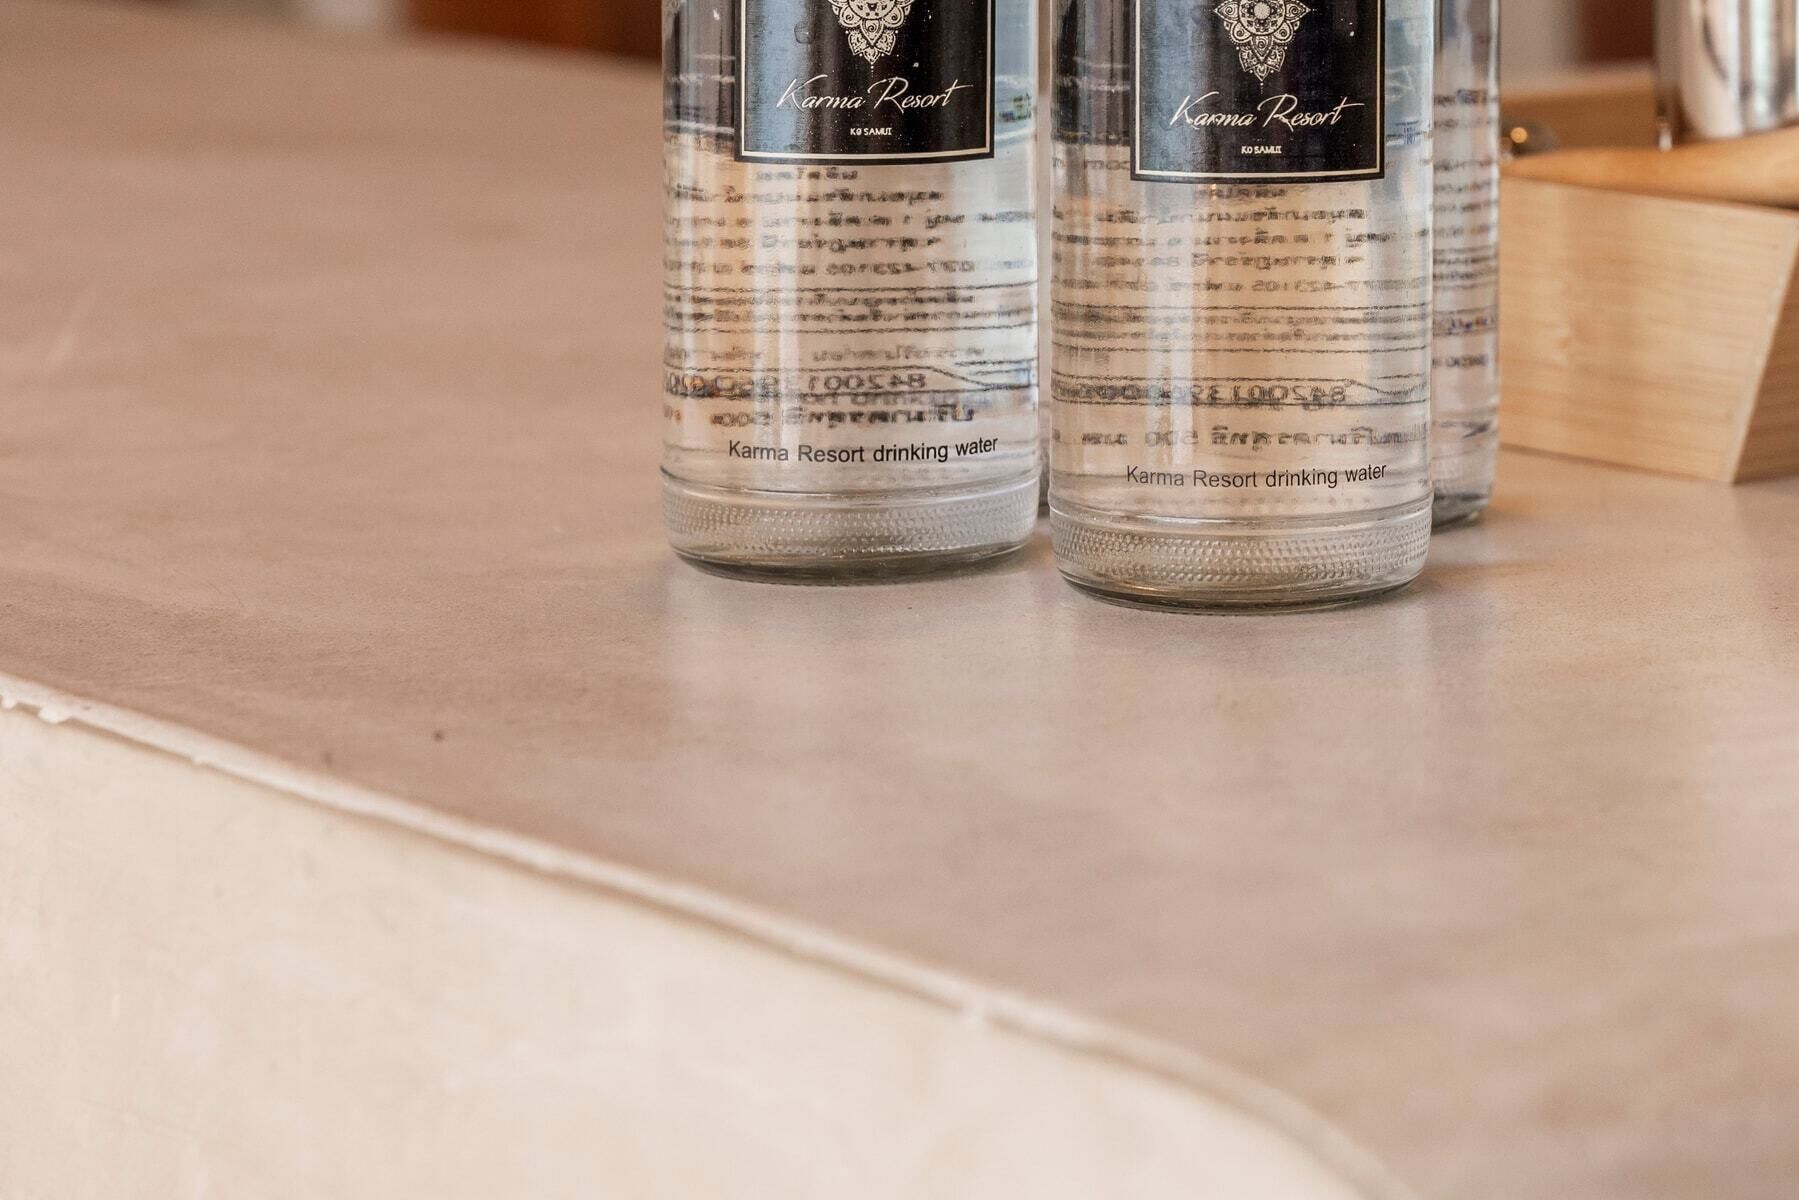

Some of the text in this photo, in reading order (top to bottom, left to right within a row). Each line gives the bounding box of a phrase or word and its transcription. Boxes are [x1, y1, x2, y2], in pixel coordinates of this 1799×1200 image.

[776, 74, 973, 114] Karma Resort
[1170, 91, 1365, 132] Karma Resort
[729, 437, 998, 463] Karma Resort drinking water
[1127, 464, 1386, 488] Karma Resort drinking water
